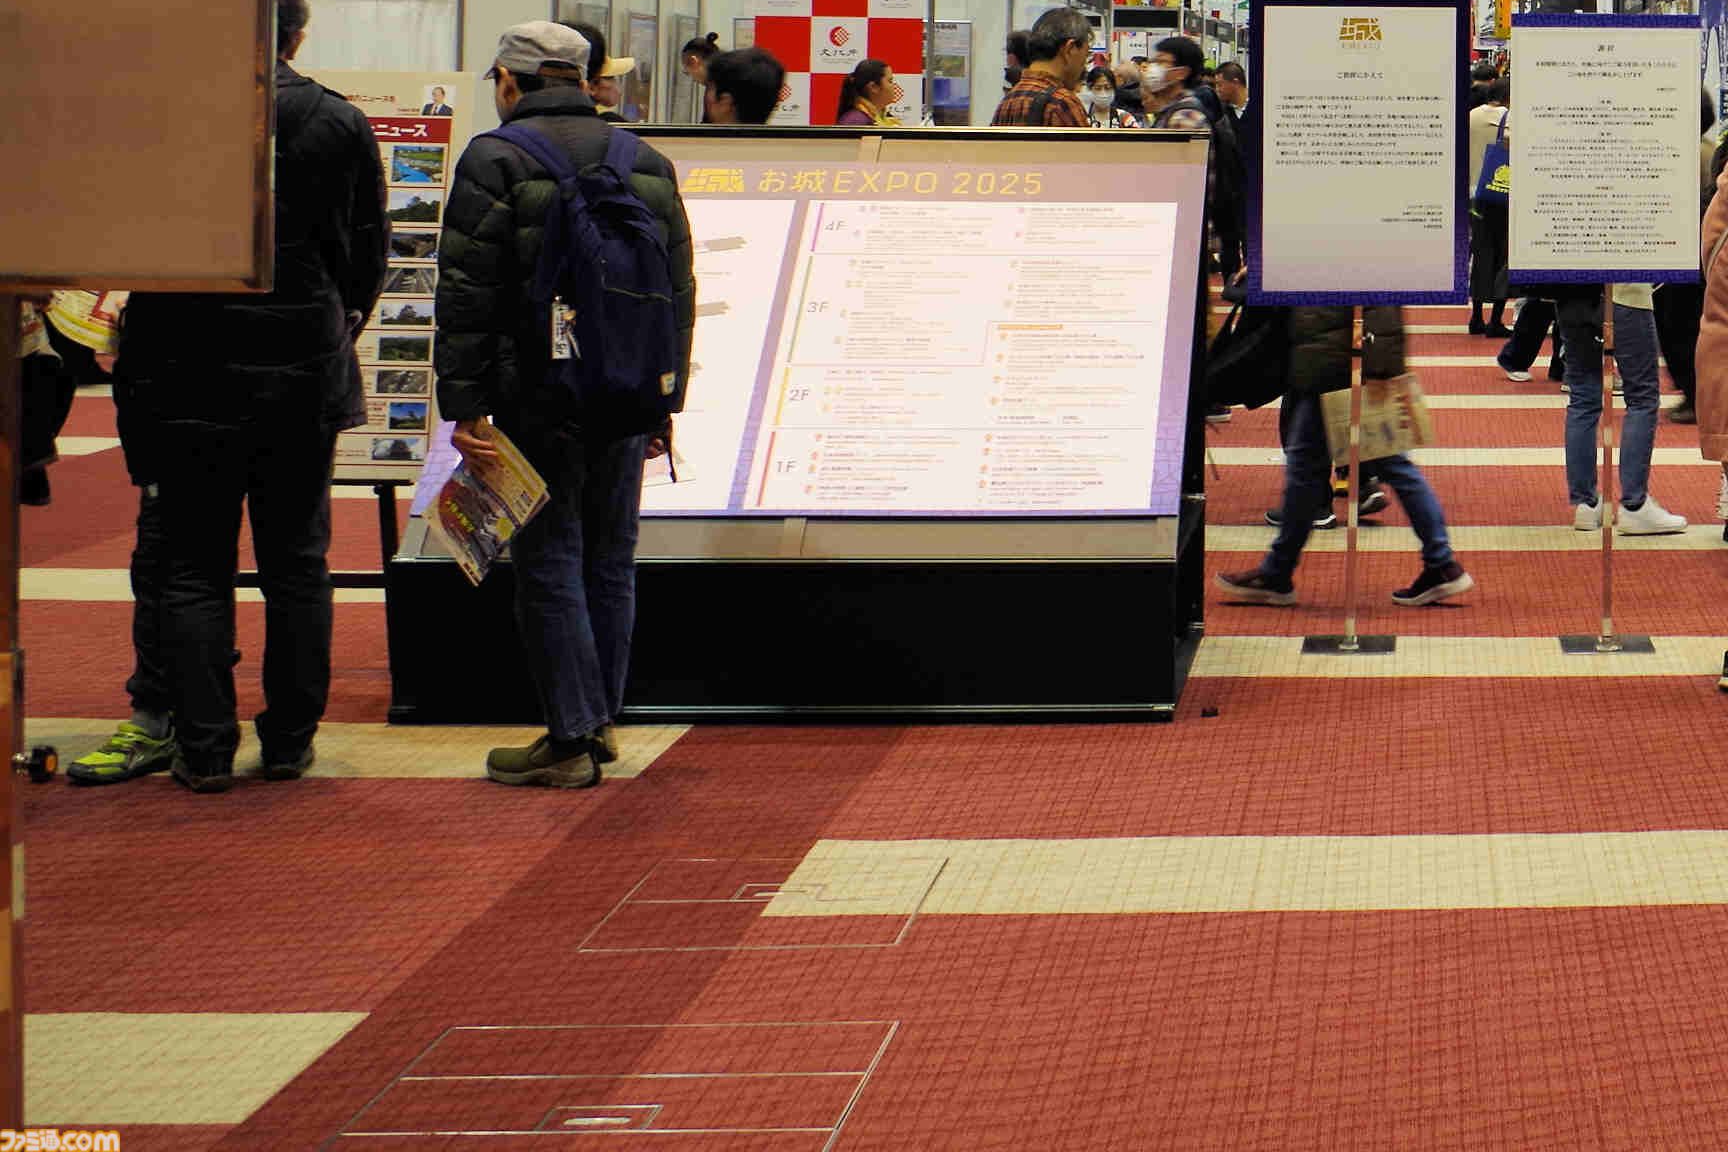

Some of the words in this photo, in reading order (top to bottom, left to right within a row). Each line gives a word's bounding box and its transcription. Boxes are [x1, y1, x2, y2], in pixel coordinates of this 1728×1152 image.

[758, 168, 938, 194] お城EXPO
[953, 172, 1043, 195] 2025
[807, 302, 830, 314] 3F
[788, 388, 811, 402] 2F
[775, 460, 797, 474] 1F
